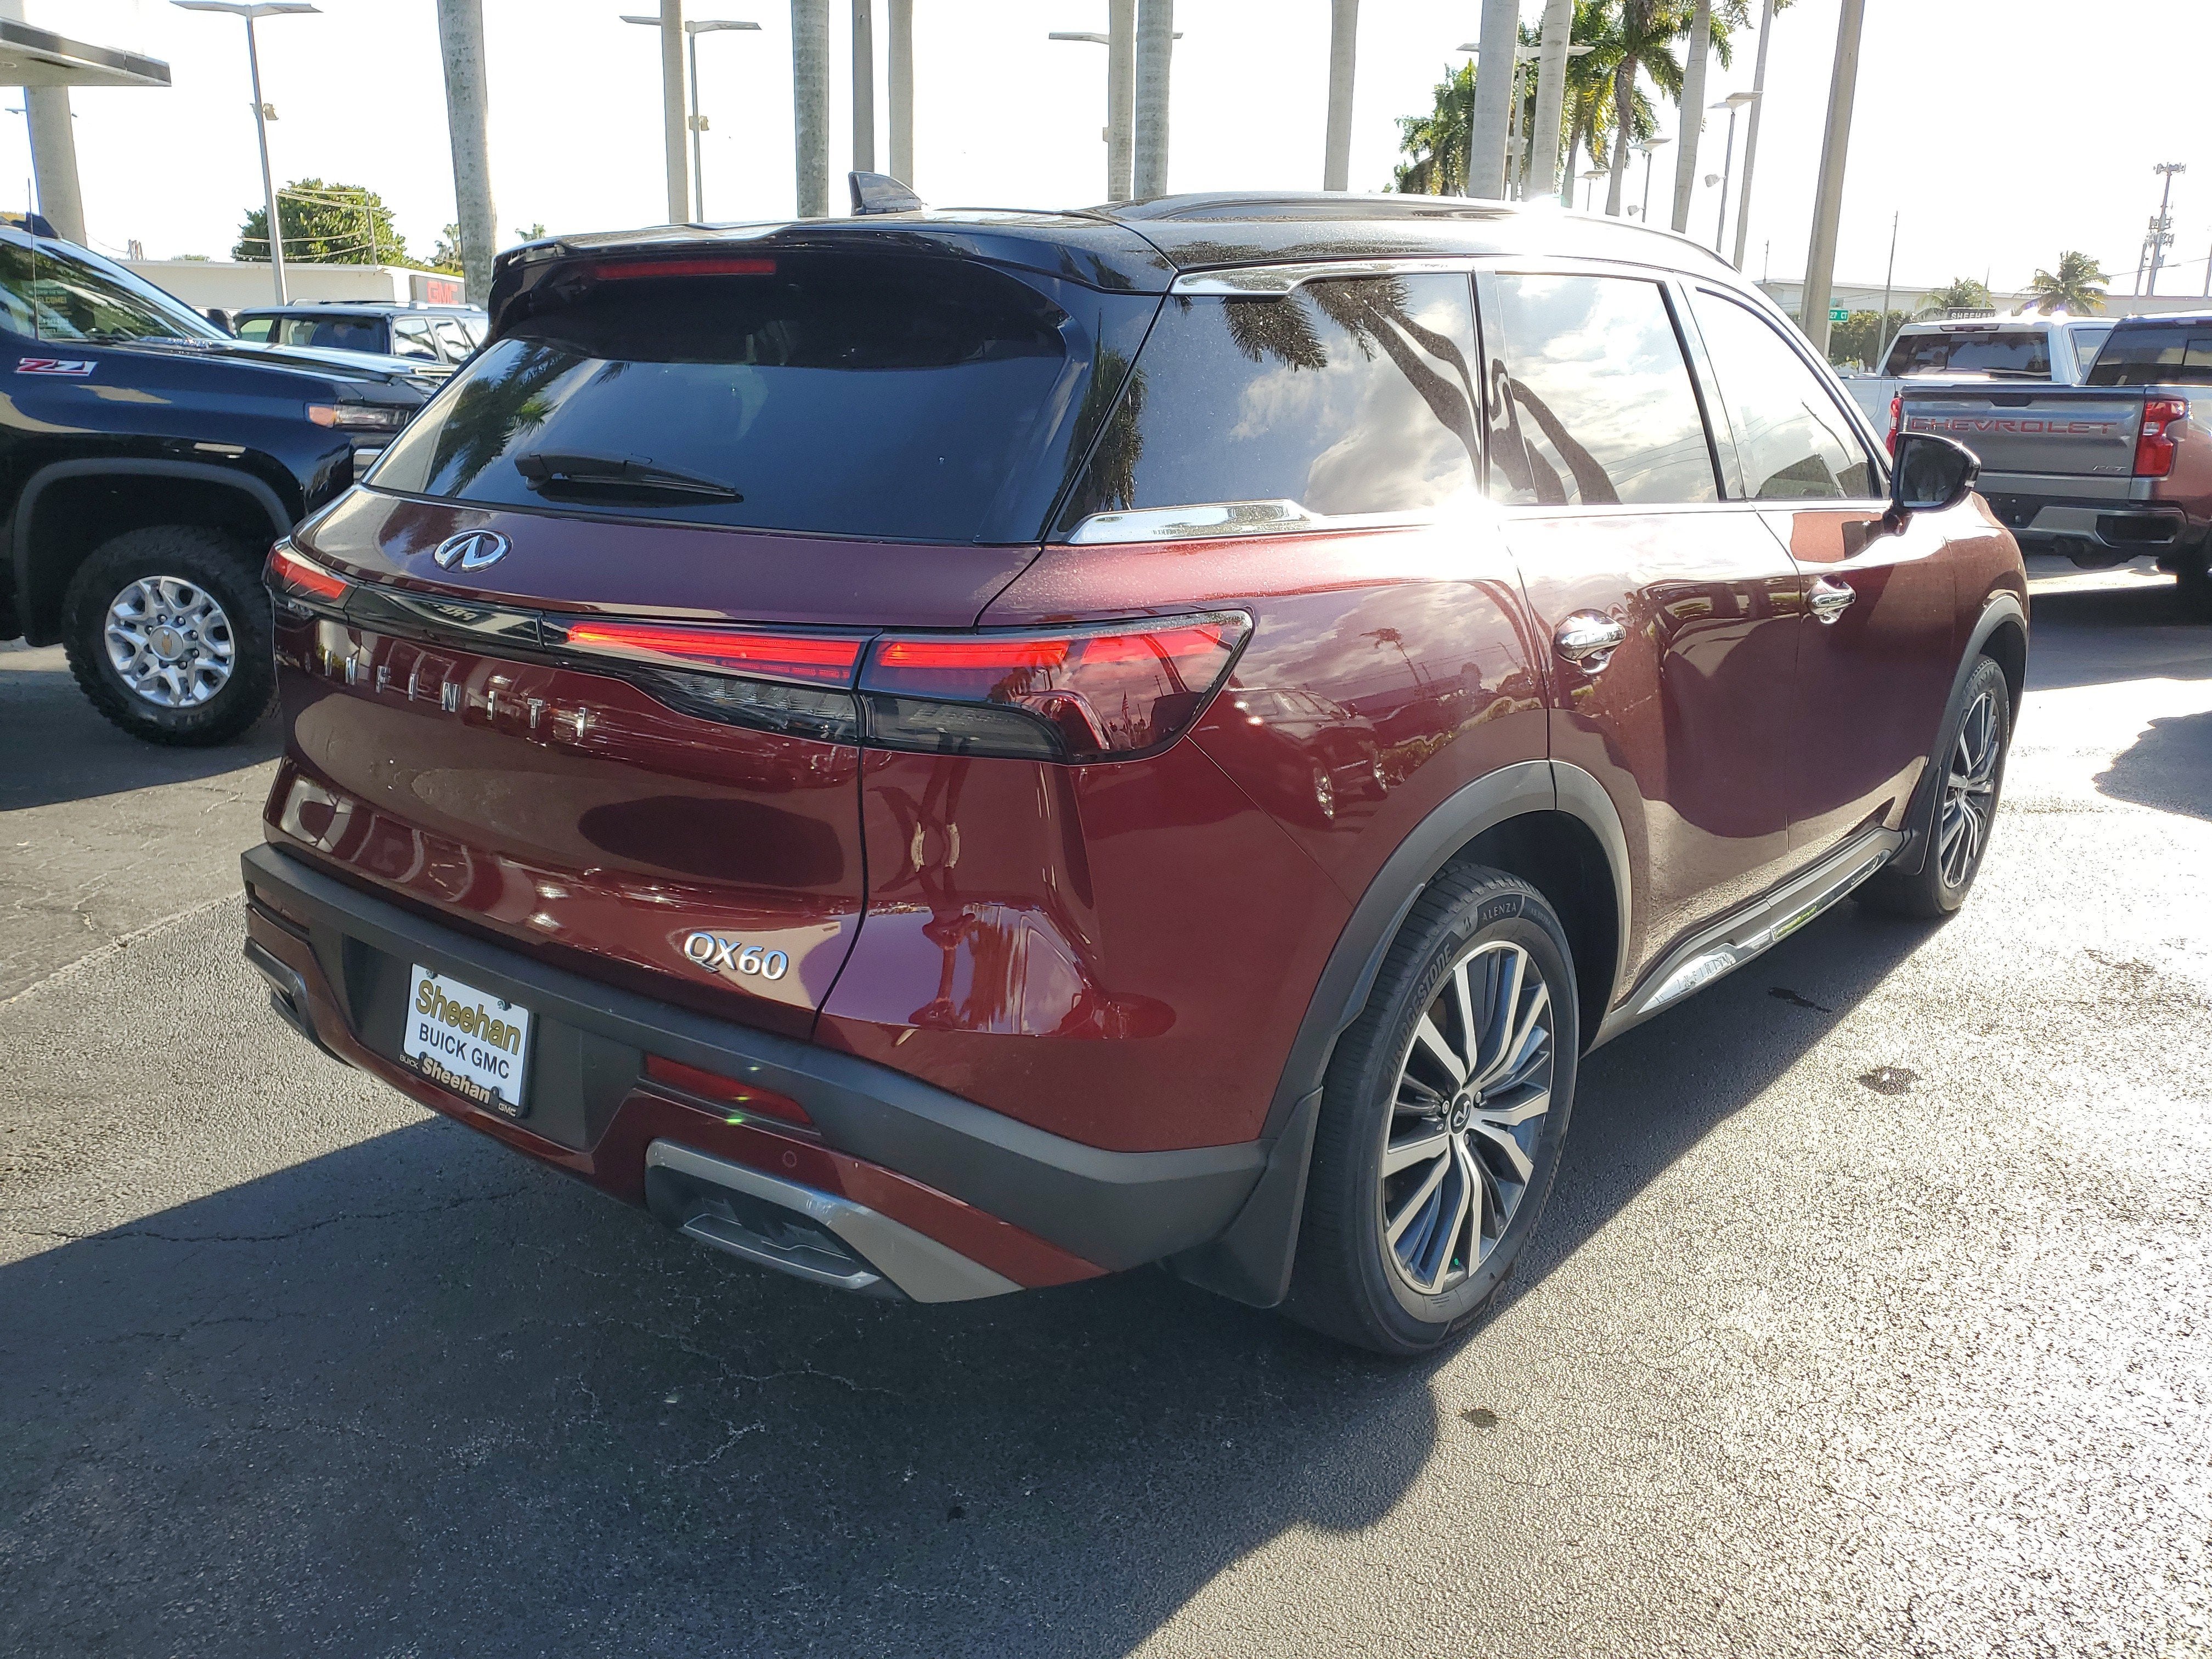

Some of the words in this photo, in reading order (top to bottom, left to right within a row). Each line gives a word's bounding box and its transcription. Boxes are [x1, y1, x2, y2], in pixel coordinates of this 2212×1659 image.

[427, 280, 459, 305] GMC
[15, 357, 99, 377] Z71
[1911, 418, 2118, 435] CHEVROLET
[324, 650, 588, 738] INFINITI
[1482, 901, 1517, 922] ALENZA
[684, 932, 788, 980] QX60
[415, 979, 522, 1056] Sheehan
[419, 1023, 469, 1062] BUICK
[471, 1047, 510, 1079] GMC
[399, 1053, 419, 1070] BUICK
[421, 1057, 491, 1104] Sheehan
[498, 1102, 517, 1118] GMC
